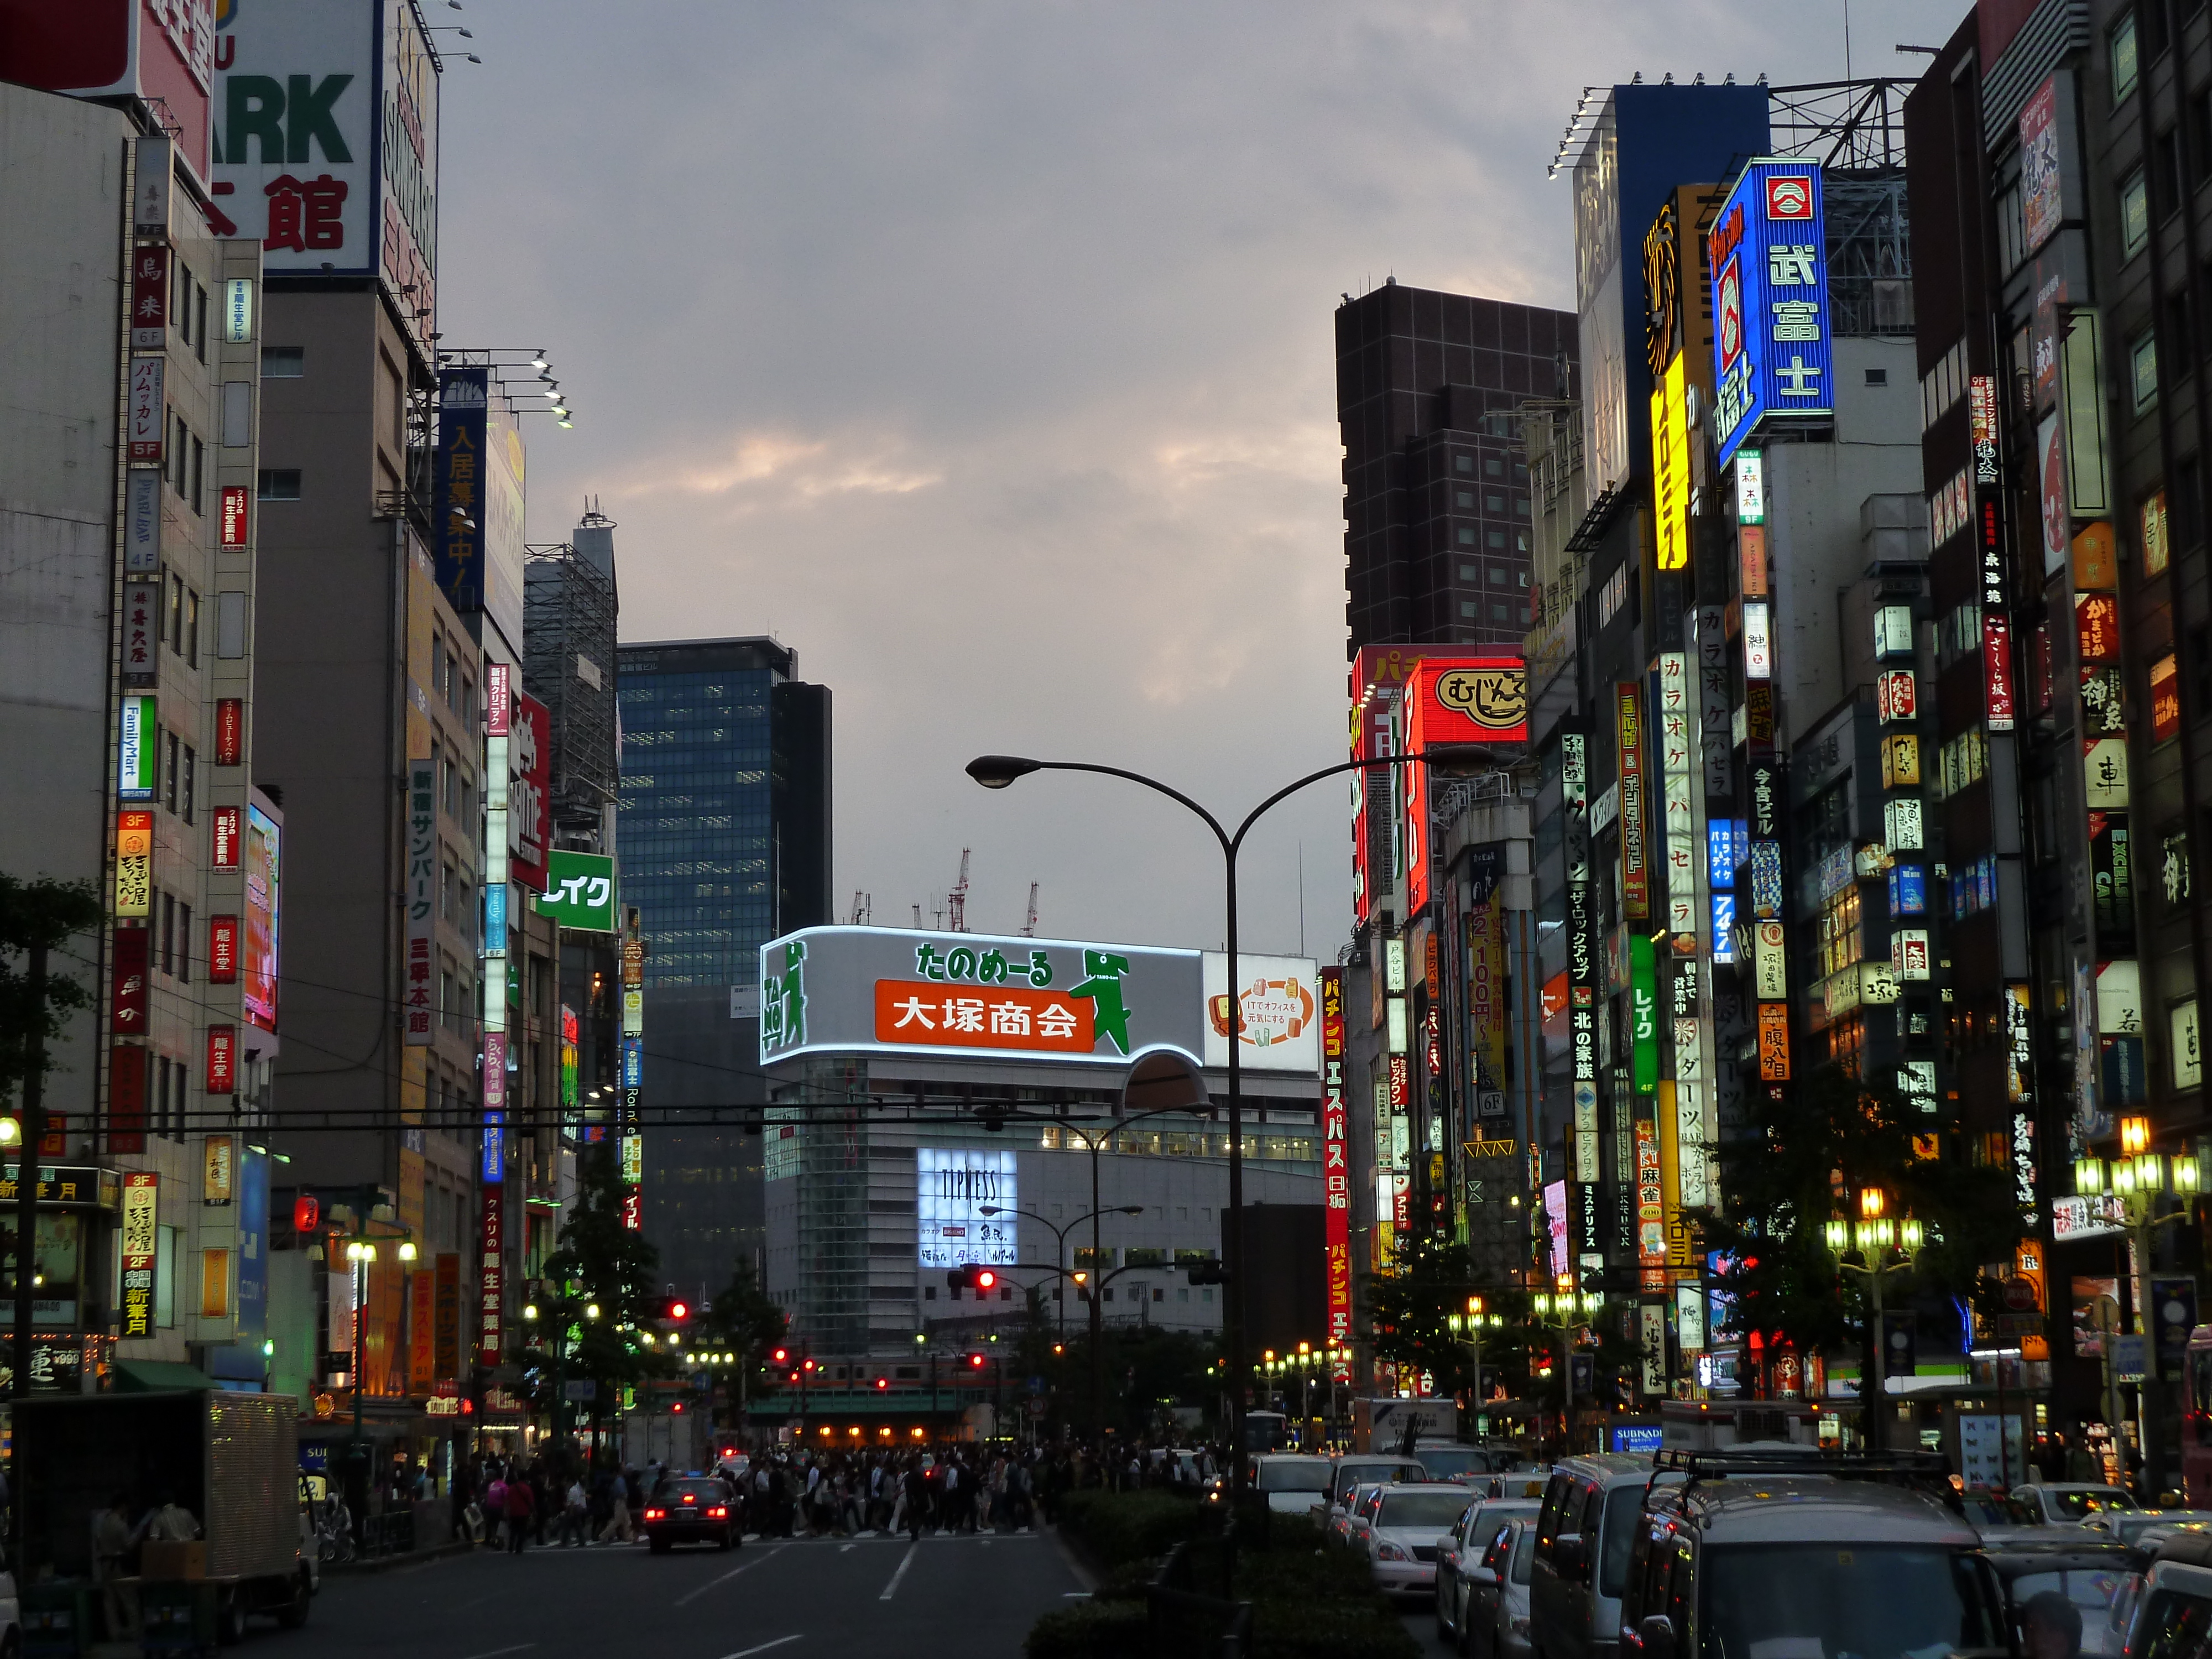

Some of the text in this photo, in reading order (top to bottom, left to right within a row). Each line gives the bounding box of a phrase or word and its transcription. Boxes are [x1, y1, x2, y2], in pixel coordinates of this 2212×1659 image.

[213, 75, 355, 164] RK
[143, 225, 161, 234] 7F
[140, 332, 158, 343] 6F
[1769, 244, 1822, 397] 武富士
[135, 362, 155, 436] パムッカレ
[1971, 376, 1985, 385] 9F
[134, 447, 157, 456] 5F
[225, 496, 237, 543] 龍生堂薬局
[1745, 515, 1758, 524] 9F
[2086, 598, 2107, 657] かまどか
[1704, 611, 1726, 731] カラオケ
[1989, 638, 2008, 696] さくら坂
[2081, 666, 2093, 674] 4F
[491, 667, 500, 726] 新宿クリニック
[1665, 659, 1685, 766] カラオケ
[1749, 688, 1773, 741] 麻雀
[127, 707, 139, 776] FamilyMart
[1992, 720, 2009, 729] 7F
[126, 815, 146, 827] 3F
[1623, 774, 1643, 874] インターネット
[1754, 768, 1773, 836] 今宮ビル
[2089, 813, 2099, 822] 2F
[216, 816, 228, 864] 龍生堂薬局
[410, 770, 432, 920] 新宿サンパーク
[1668, 797, 1689, 922] パセラ
[1712, 832, 1720, 880] パーティ
[1721, 832, 1731, 881] カラオケ
[541, 872, 610, 907] レイク
[1715, 896, 1732, 951] 747
[216, 929, 230, 971] 龍生堂
[916, 943, 1053, 987] たのめーる
[409, 938, 430, 1033] 三平本館
[1673, 977, 1687, 1014] 営業中
[1684, 961, 1696, 999] 朝まで
[893, 997, 1078, 1039] 大塚商会
[1247, 1001, 1297, 1013] ITでオフィスを
[1247, 1013, 1285, 1024] 元気にする
[1324, 978, 1340, 1056] パチンコ
[1636, 988, 1652, 1039] レイク
[213, 1037, 228, 1077] 龍生堂
[1573, 1012, 1594, 1079] 北の家族
[1327, 1061, 1344, 1168] エスパス
[1484, 1094, 1500, 1110] 6F
[1681, 1058, 1699, 1127] ダーツ
[1581, 1113, 1593, 1181] アラビアンロック
[132, 1175, 150, 1186] 3F
[942, 1155, 996, 1214] TIPNESS
[1640, 1167, 1660, 1203] 麻雀
[487, 1198, 497, 1248] クスリの
[1397, 1196, 1407, 1222] アコム
[1584, 1185, 1597, 1248] ミステリアス
[130, 1258, 148, 1267] 2F
[1332, 1243, 1347, 1305] パチンコ
[125, 1288, 149, 1335] 新華月
[482, 1251, 500, 1352] 龍生堂薬局
